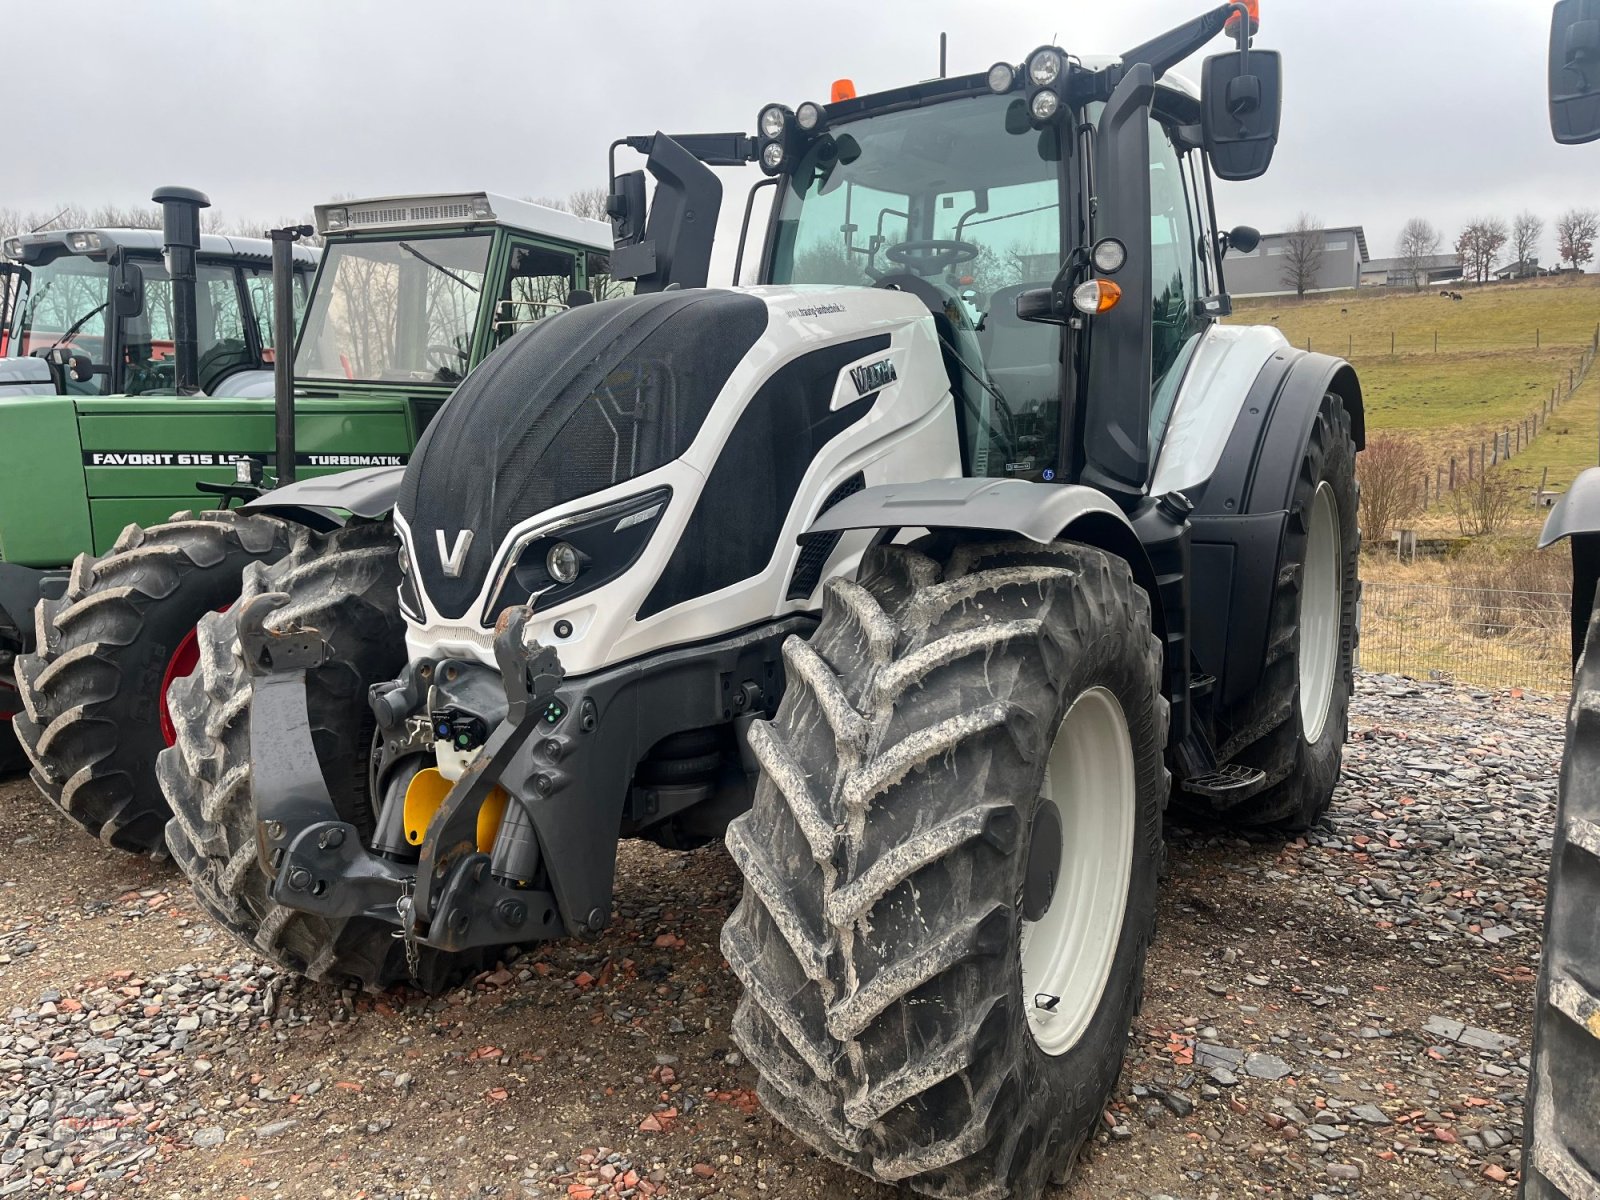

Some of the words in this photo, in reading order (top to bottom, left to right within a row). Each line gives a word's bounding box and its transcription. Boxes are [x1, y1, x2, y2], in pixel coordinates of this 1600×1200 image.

[93, 454, 173, 465] FAVORIT
[178, 454, 213, 465] 615
[309, 455, 401, 465] TURBOMATIK
[436, 529, 474, 577] V
